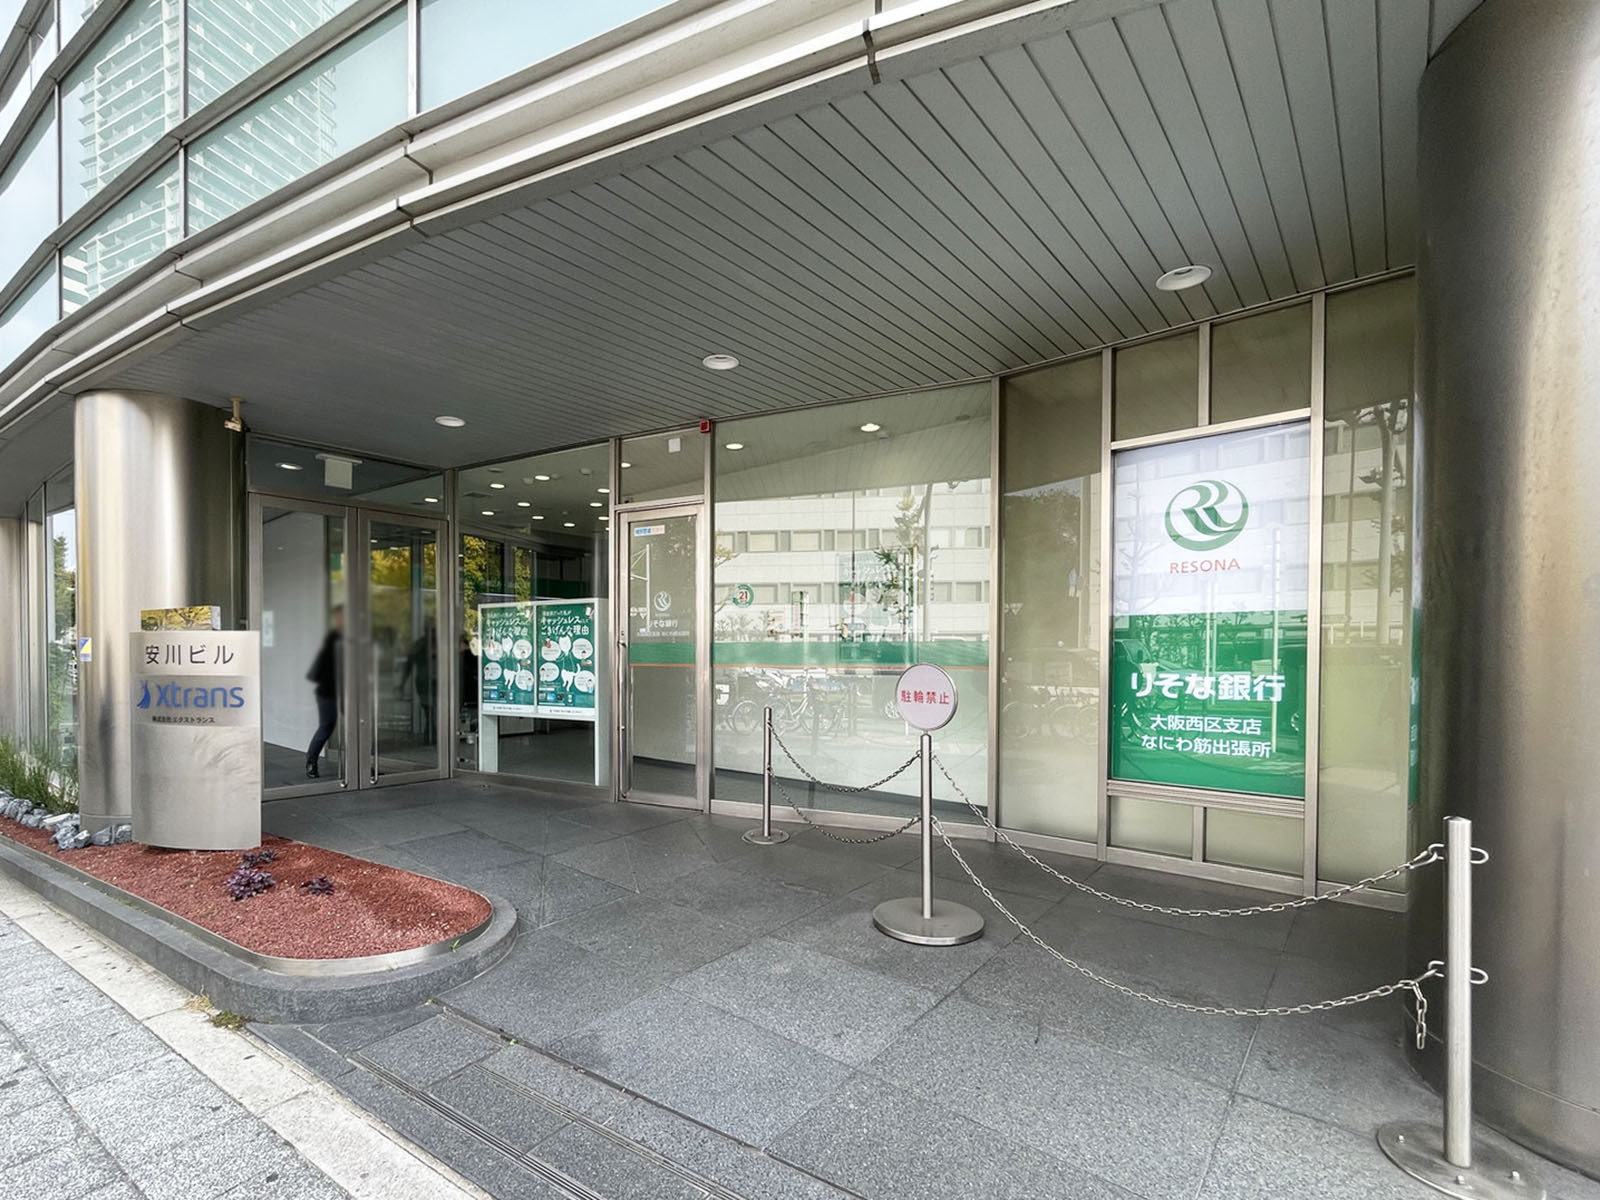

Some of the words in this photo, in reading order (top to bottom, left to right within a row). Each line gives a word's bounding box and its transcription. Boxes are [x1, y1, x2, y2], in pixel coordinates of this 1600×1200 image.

[1169, 558, 1241, 575] RESONA
[145, 644, 235, 666] 安川ビル
[156, 681, 245, 709] xtrans
[901, 690, 949, 705] 駐輪禁止
[1130, 672, 1286, 702] りそな銀行
[1150, 713, 1263, 736] 大阪西区支店
[1140, 734, 1273, 759] なにわ筋出張所
